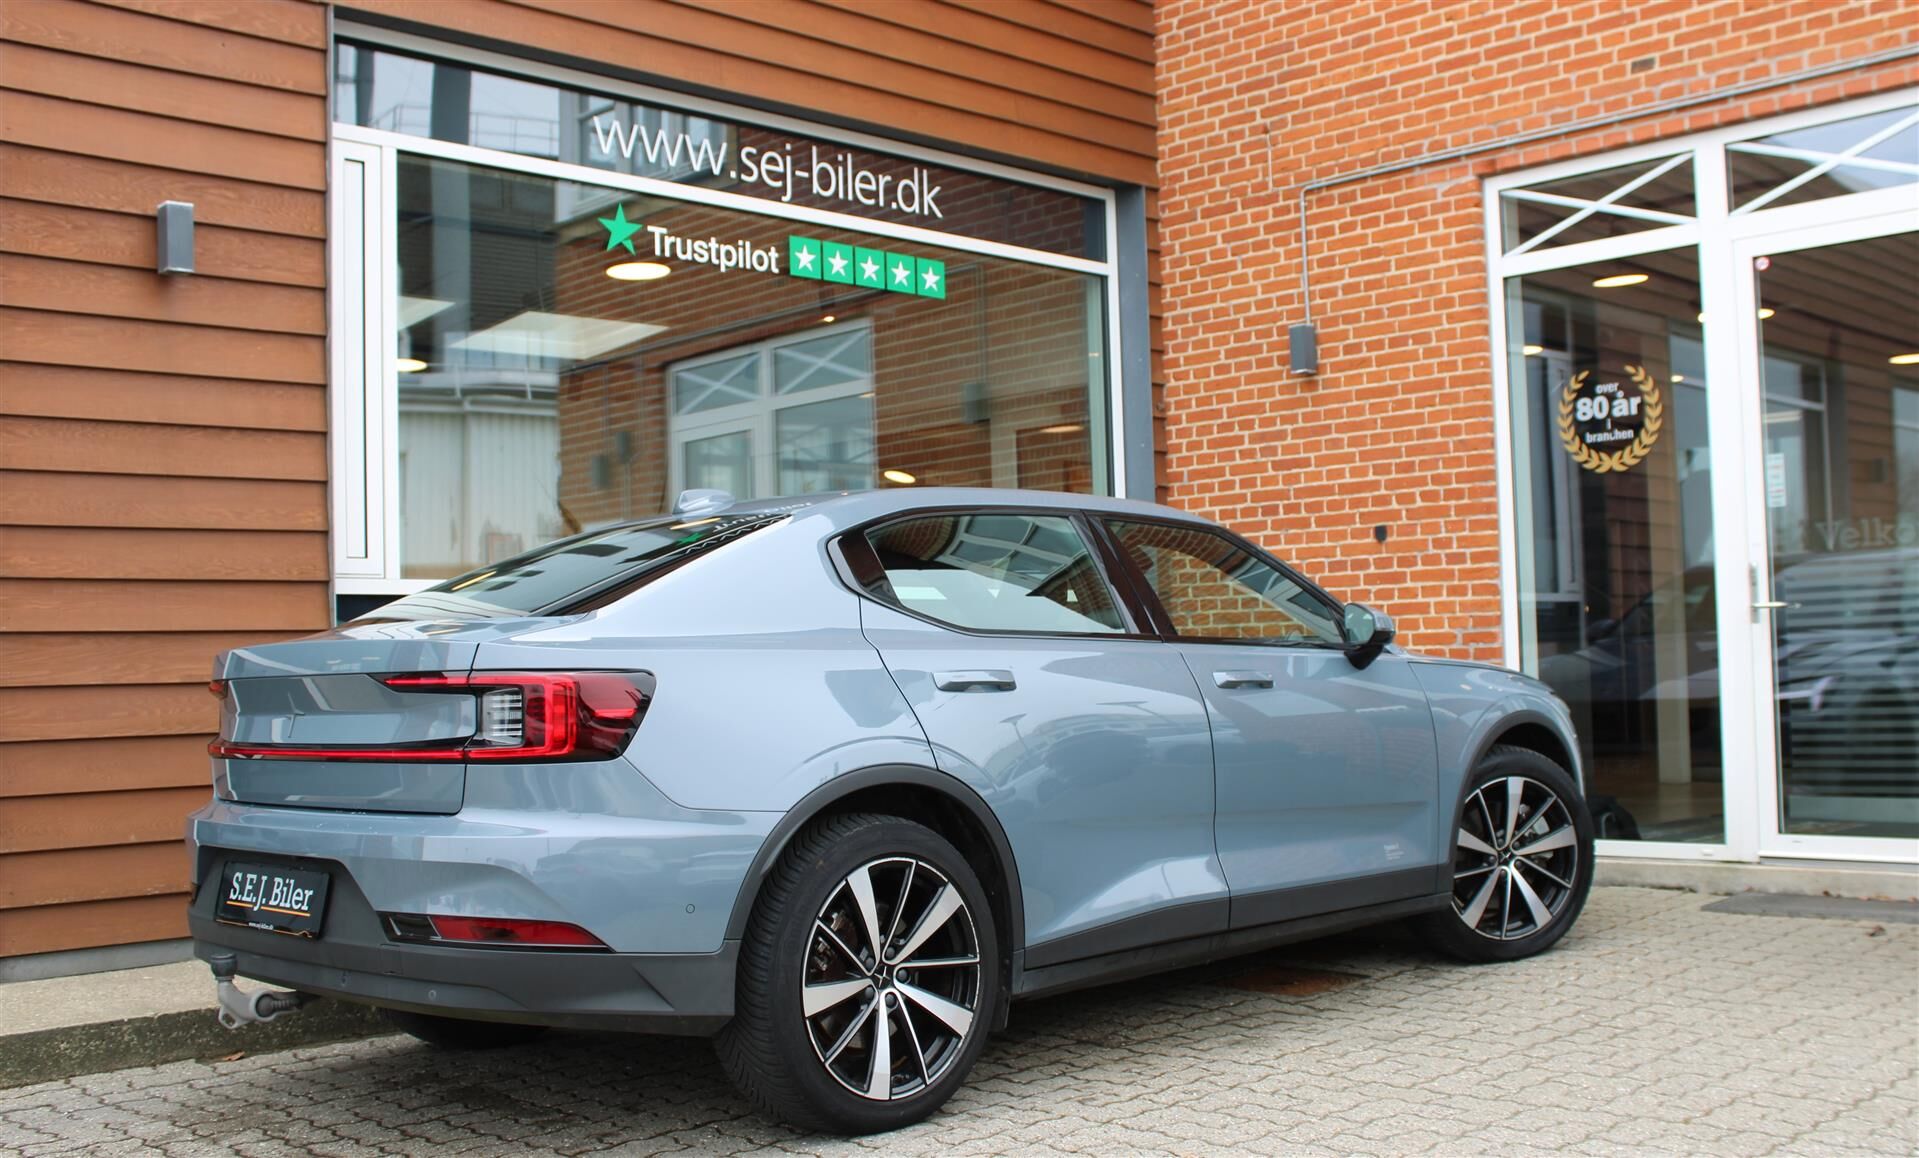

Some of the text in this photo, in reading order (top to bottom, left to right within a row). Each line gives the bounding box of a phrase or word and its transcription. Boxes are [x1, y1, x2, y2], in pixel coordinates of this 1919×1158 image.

[593, 116, 943, 218] www.sej-biler.dk
[647, 225, 779, 273] Trustpilot
[1576, 390, 1641, 421] 80 år
[1595, 383, 1619, 394] over
[229, 871, 314, 911] S.E.J. Biler
